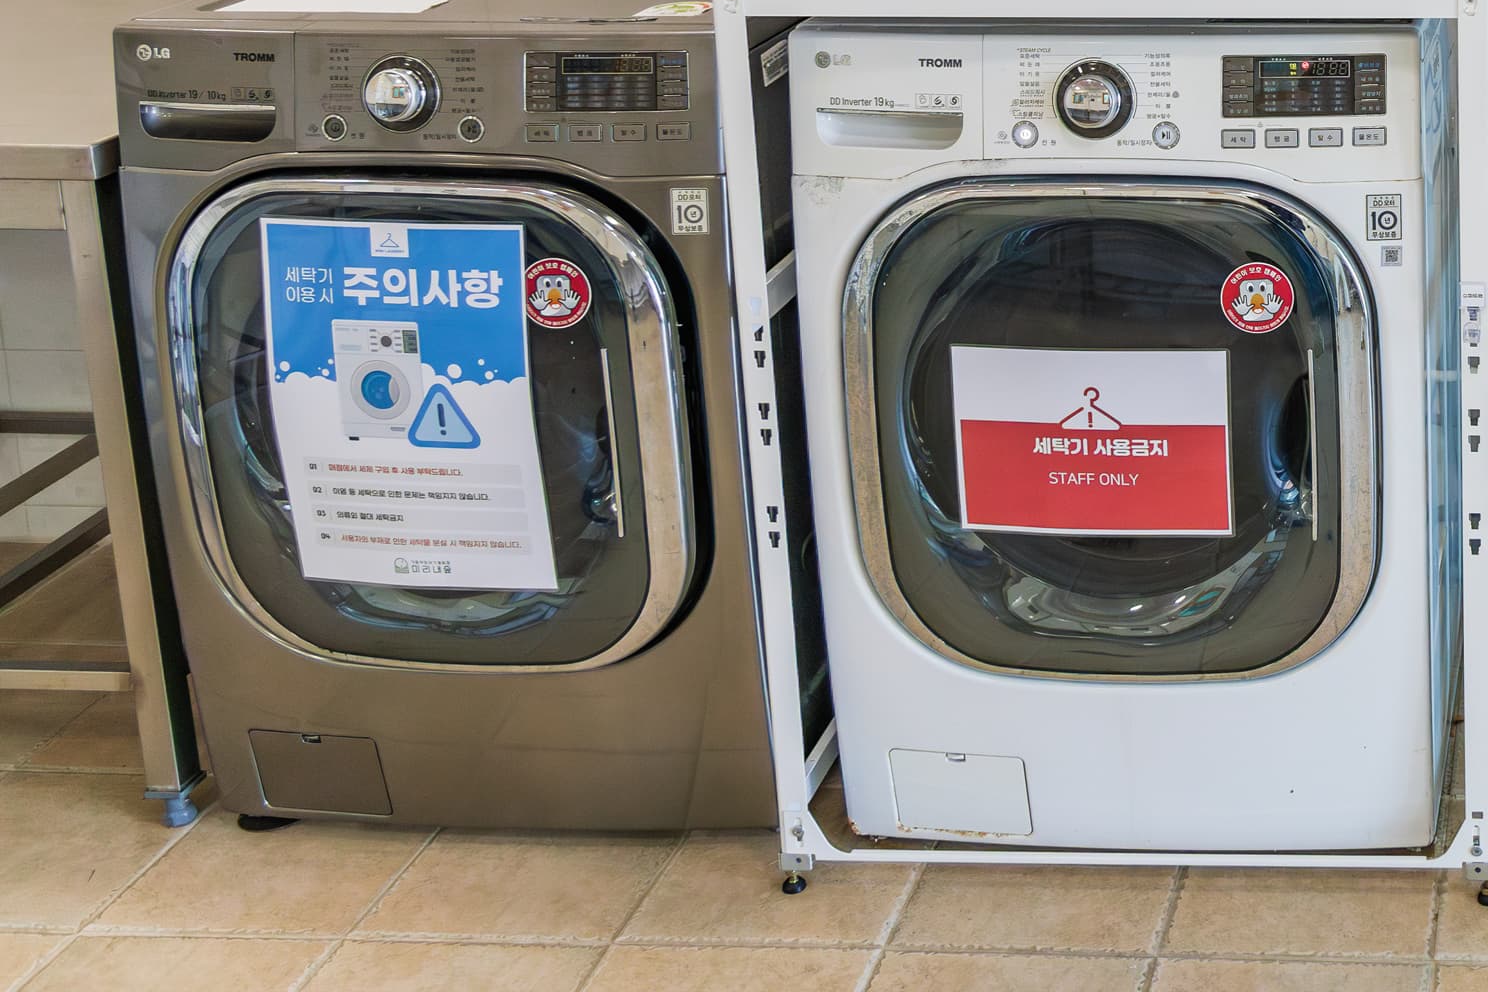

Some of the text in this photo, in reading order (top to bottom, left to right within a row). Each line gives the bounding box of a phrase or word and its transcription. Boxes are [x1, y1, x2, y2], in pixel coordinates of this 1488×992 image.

[153, 48, 170, 58] LG
[233, 52, 275, 62] TROMM
[918, 58, 963, 68] TROMM
[830, 96, 841, 106] DD
[842, 97, 872, 106] Inverter
[284, 266, 333, 285] 세탁기
[343, 266, 504, 309] 주의사항
[286, 286, 334, 304] 이용 시
[1032, 437, 1169, 456] 세탁기 사용금지
[1048, 472, 1139, 486] STAFF ONLY
